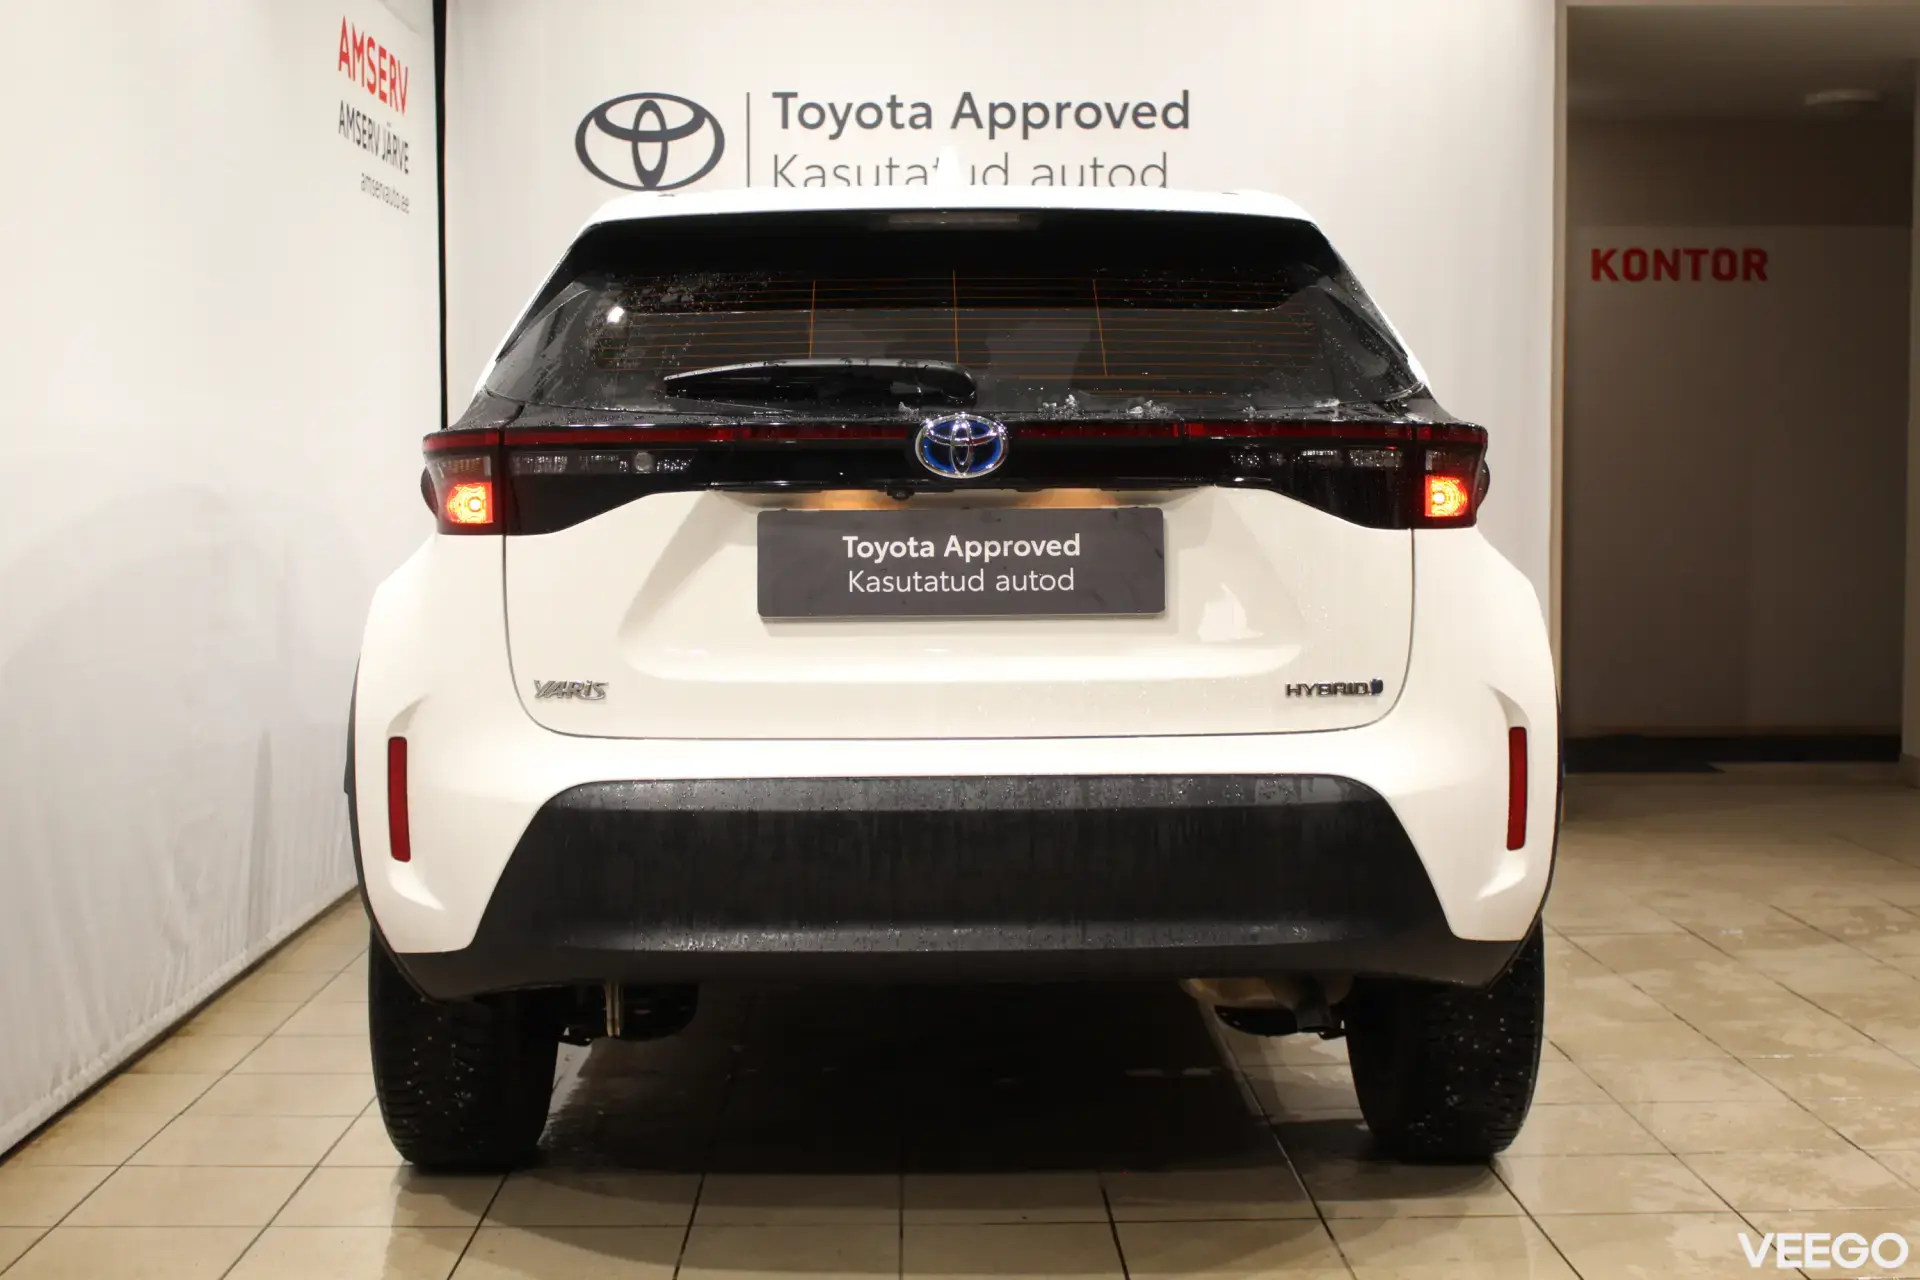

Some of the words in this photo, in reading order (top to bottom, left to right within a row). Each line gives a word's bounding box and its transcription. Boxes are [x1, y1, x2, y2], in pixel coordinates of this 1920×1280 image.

[338, 15, 409, 116] AMSERV
[772, 92, 933, 140] Toyota
[950, 90, 1191, 140] Approved
[338, 99, 381, 157] AMSERV
[381, 121, 409, 175] JÄRVE
[1031, 151, 1167, 189] autod
[1591, 247, 1769, 282] KONTOR
[842, 535, 936, 563] Toyota
[943, 533, 1082, 563] Approved
[848, 568, 985, 593] Kasutatud
[995, 567, 1075, 592] autod
[1285, 682, 1369, 697] HYBRID
